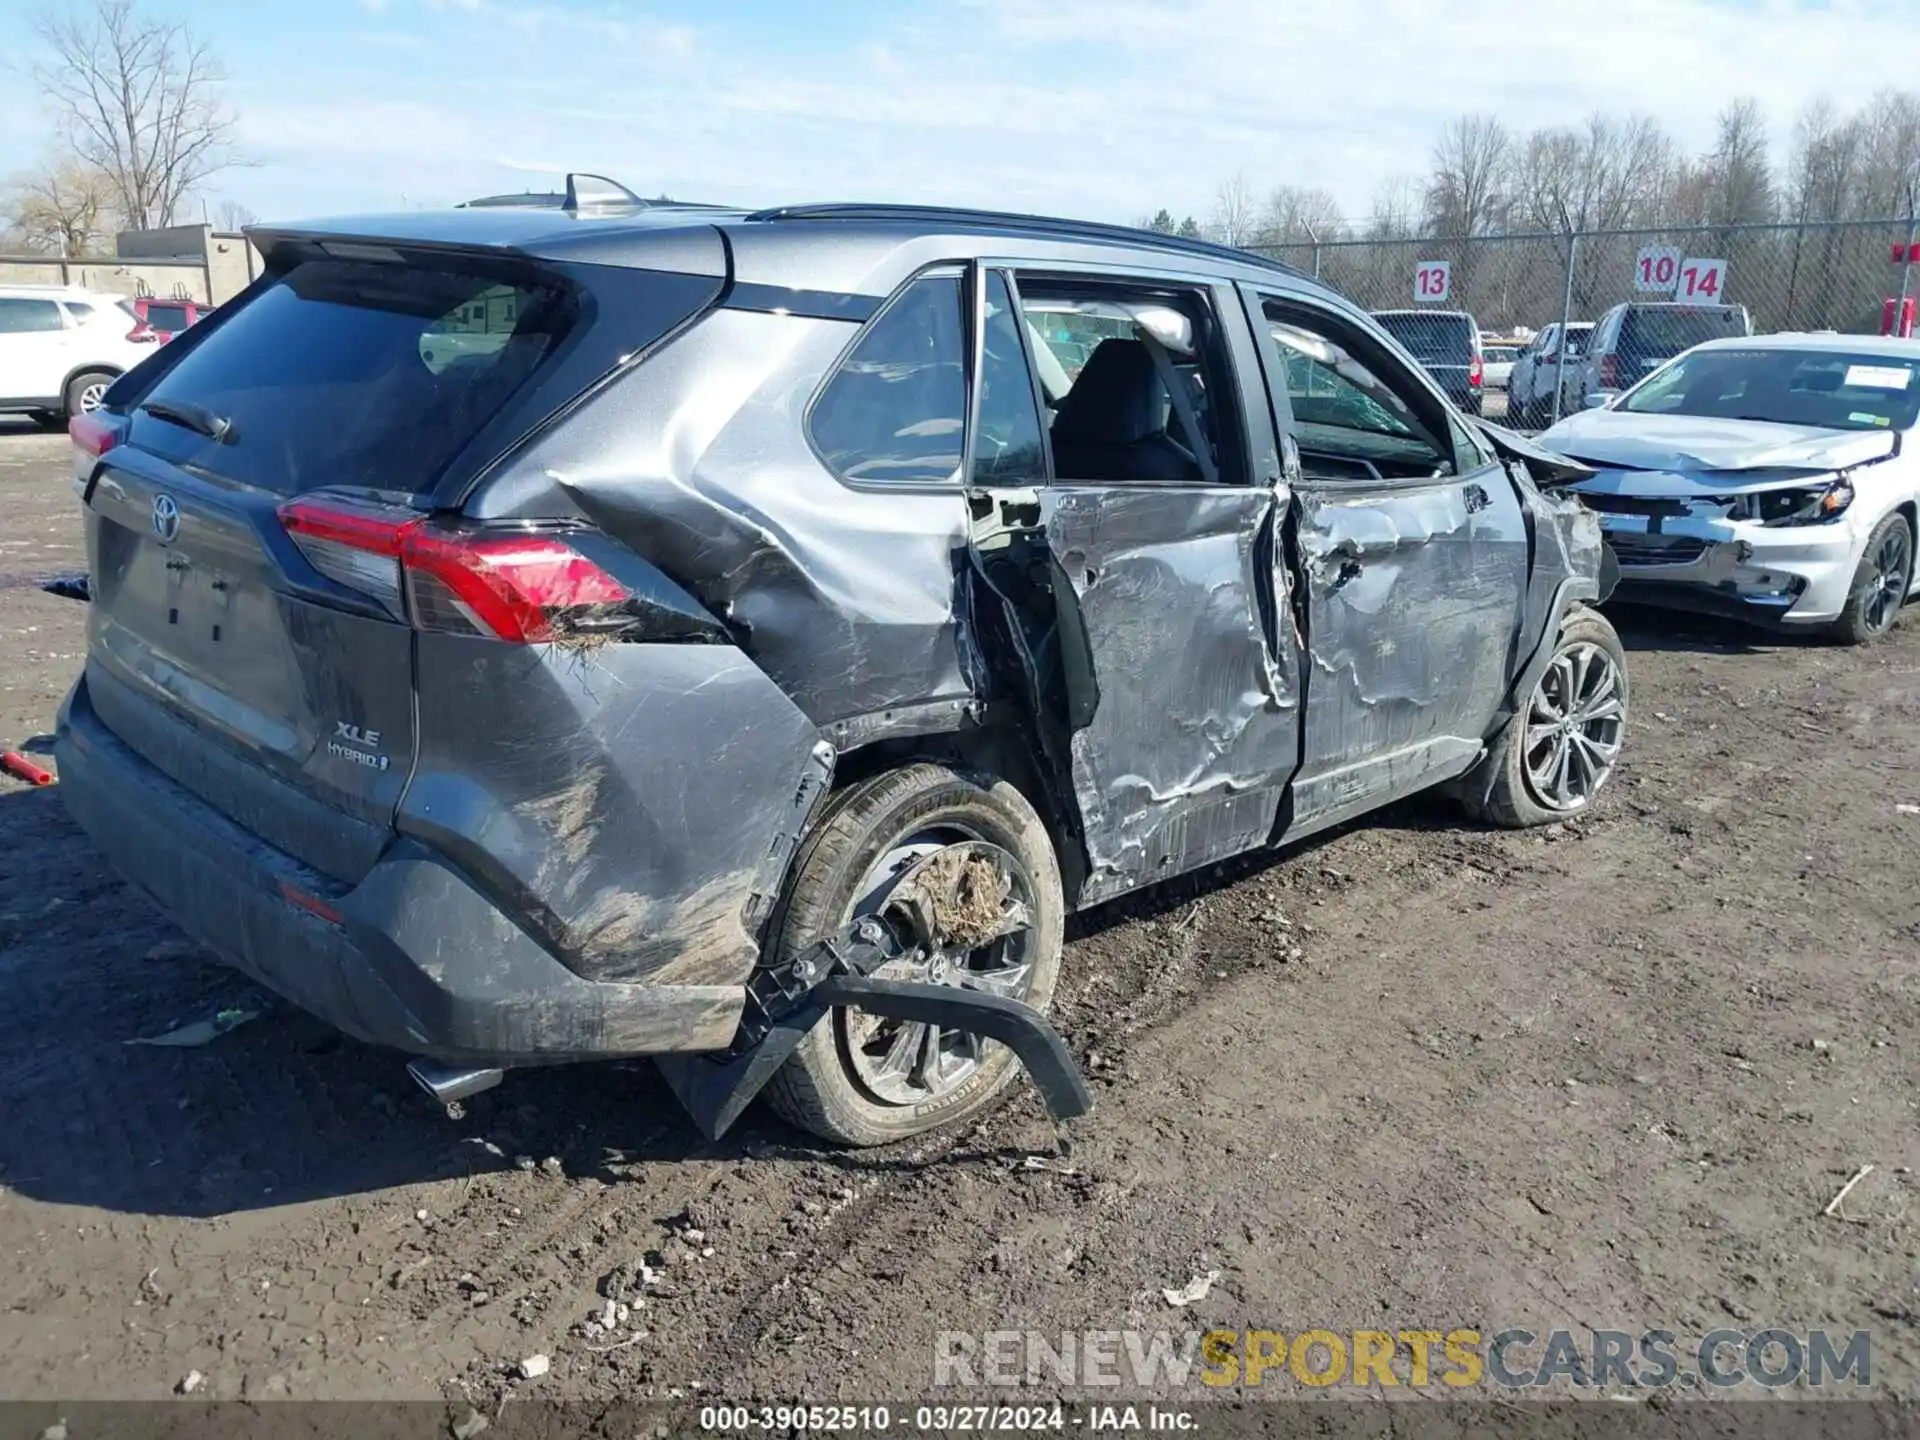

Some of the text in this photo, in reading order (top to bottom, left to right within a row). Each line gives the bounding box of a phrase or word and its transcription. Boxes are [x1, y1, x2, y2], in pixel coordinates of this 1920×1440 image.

[1419, 268, 1445, 294] 13
[1641, 257, 1674, 284] 10
[1684, 267, 1718, 297] 14
[334, 720, 380, 747] XLE
[327, 740, 378, 768] HYBRID
